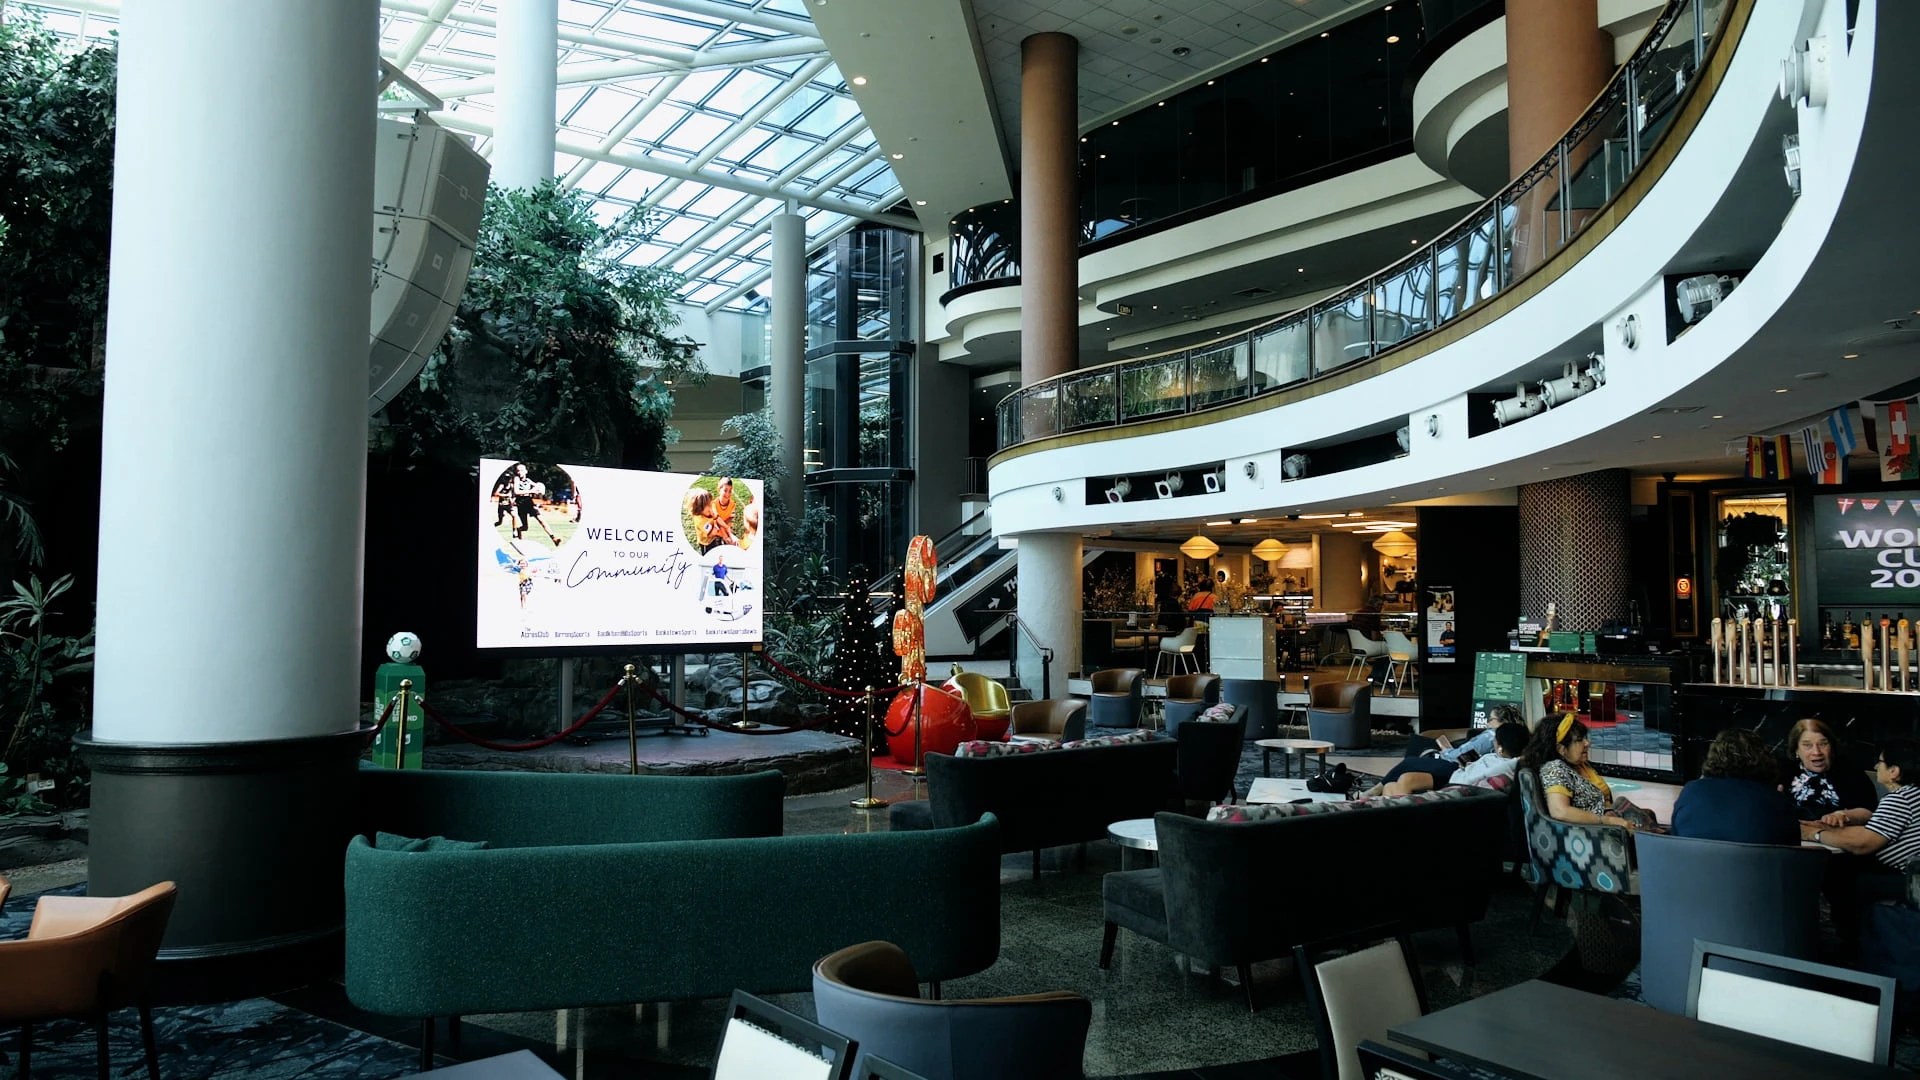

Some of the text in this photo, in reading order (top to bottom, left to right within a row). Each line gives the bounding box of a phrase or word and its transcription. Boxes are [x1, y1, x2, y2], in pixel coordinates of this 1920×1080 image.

[587, 527, 674, 543] WELCOME
[1838, 528, 1920, 549] WO
[629, 551, 649, 559] OUR
[566, 547, 693, 590] Community
